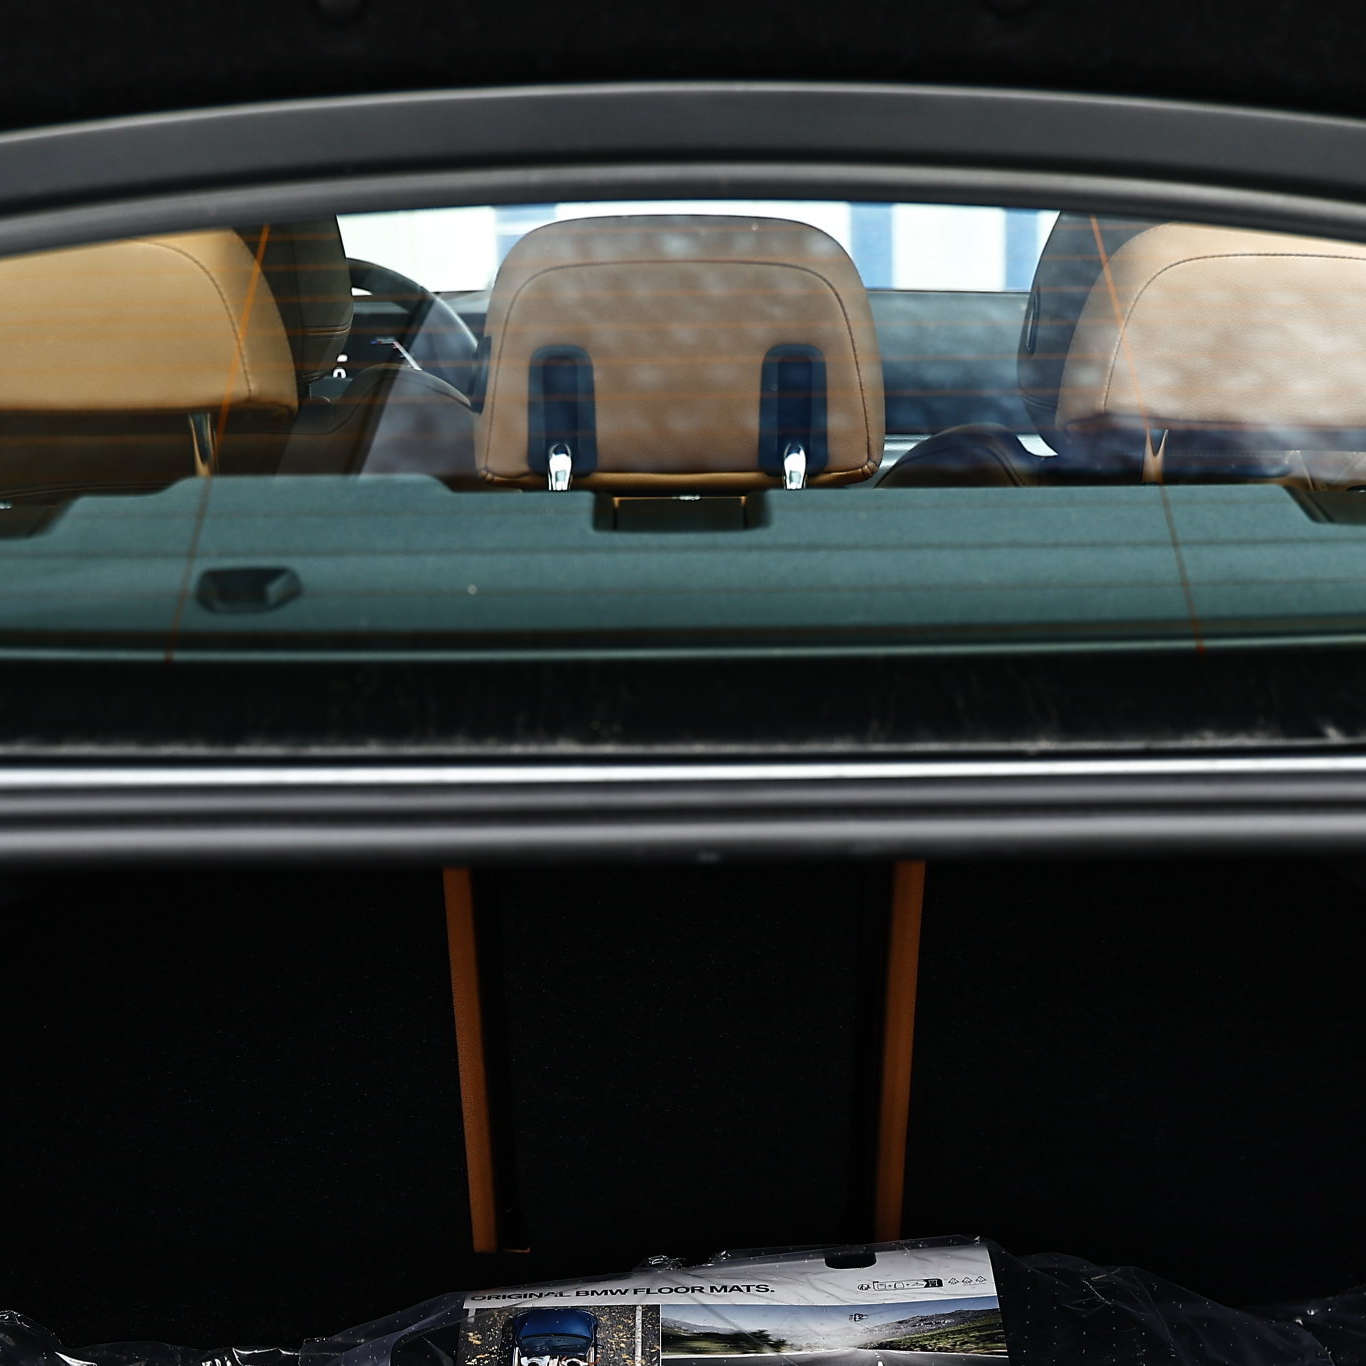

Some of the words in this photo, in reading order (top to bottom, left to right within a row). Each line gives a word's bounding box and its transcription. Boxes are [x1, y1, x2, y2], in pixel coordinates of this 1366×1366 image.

[471, 1291, 572, 1301] ORIGINAL
[575, 1288, 629, 1297] BMW
[633, 1286, 705, 1295] FLOOR
[709, 1284, 775, 1294] MATS.
